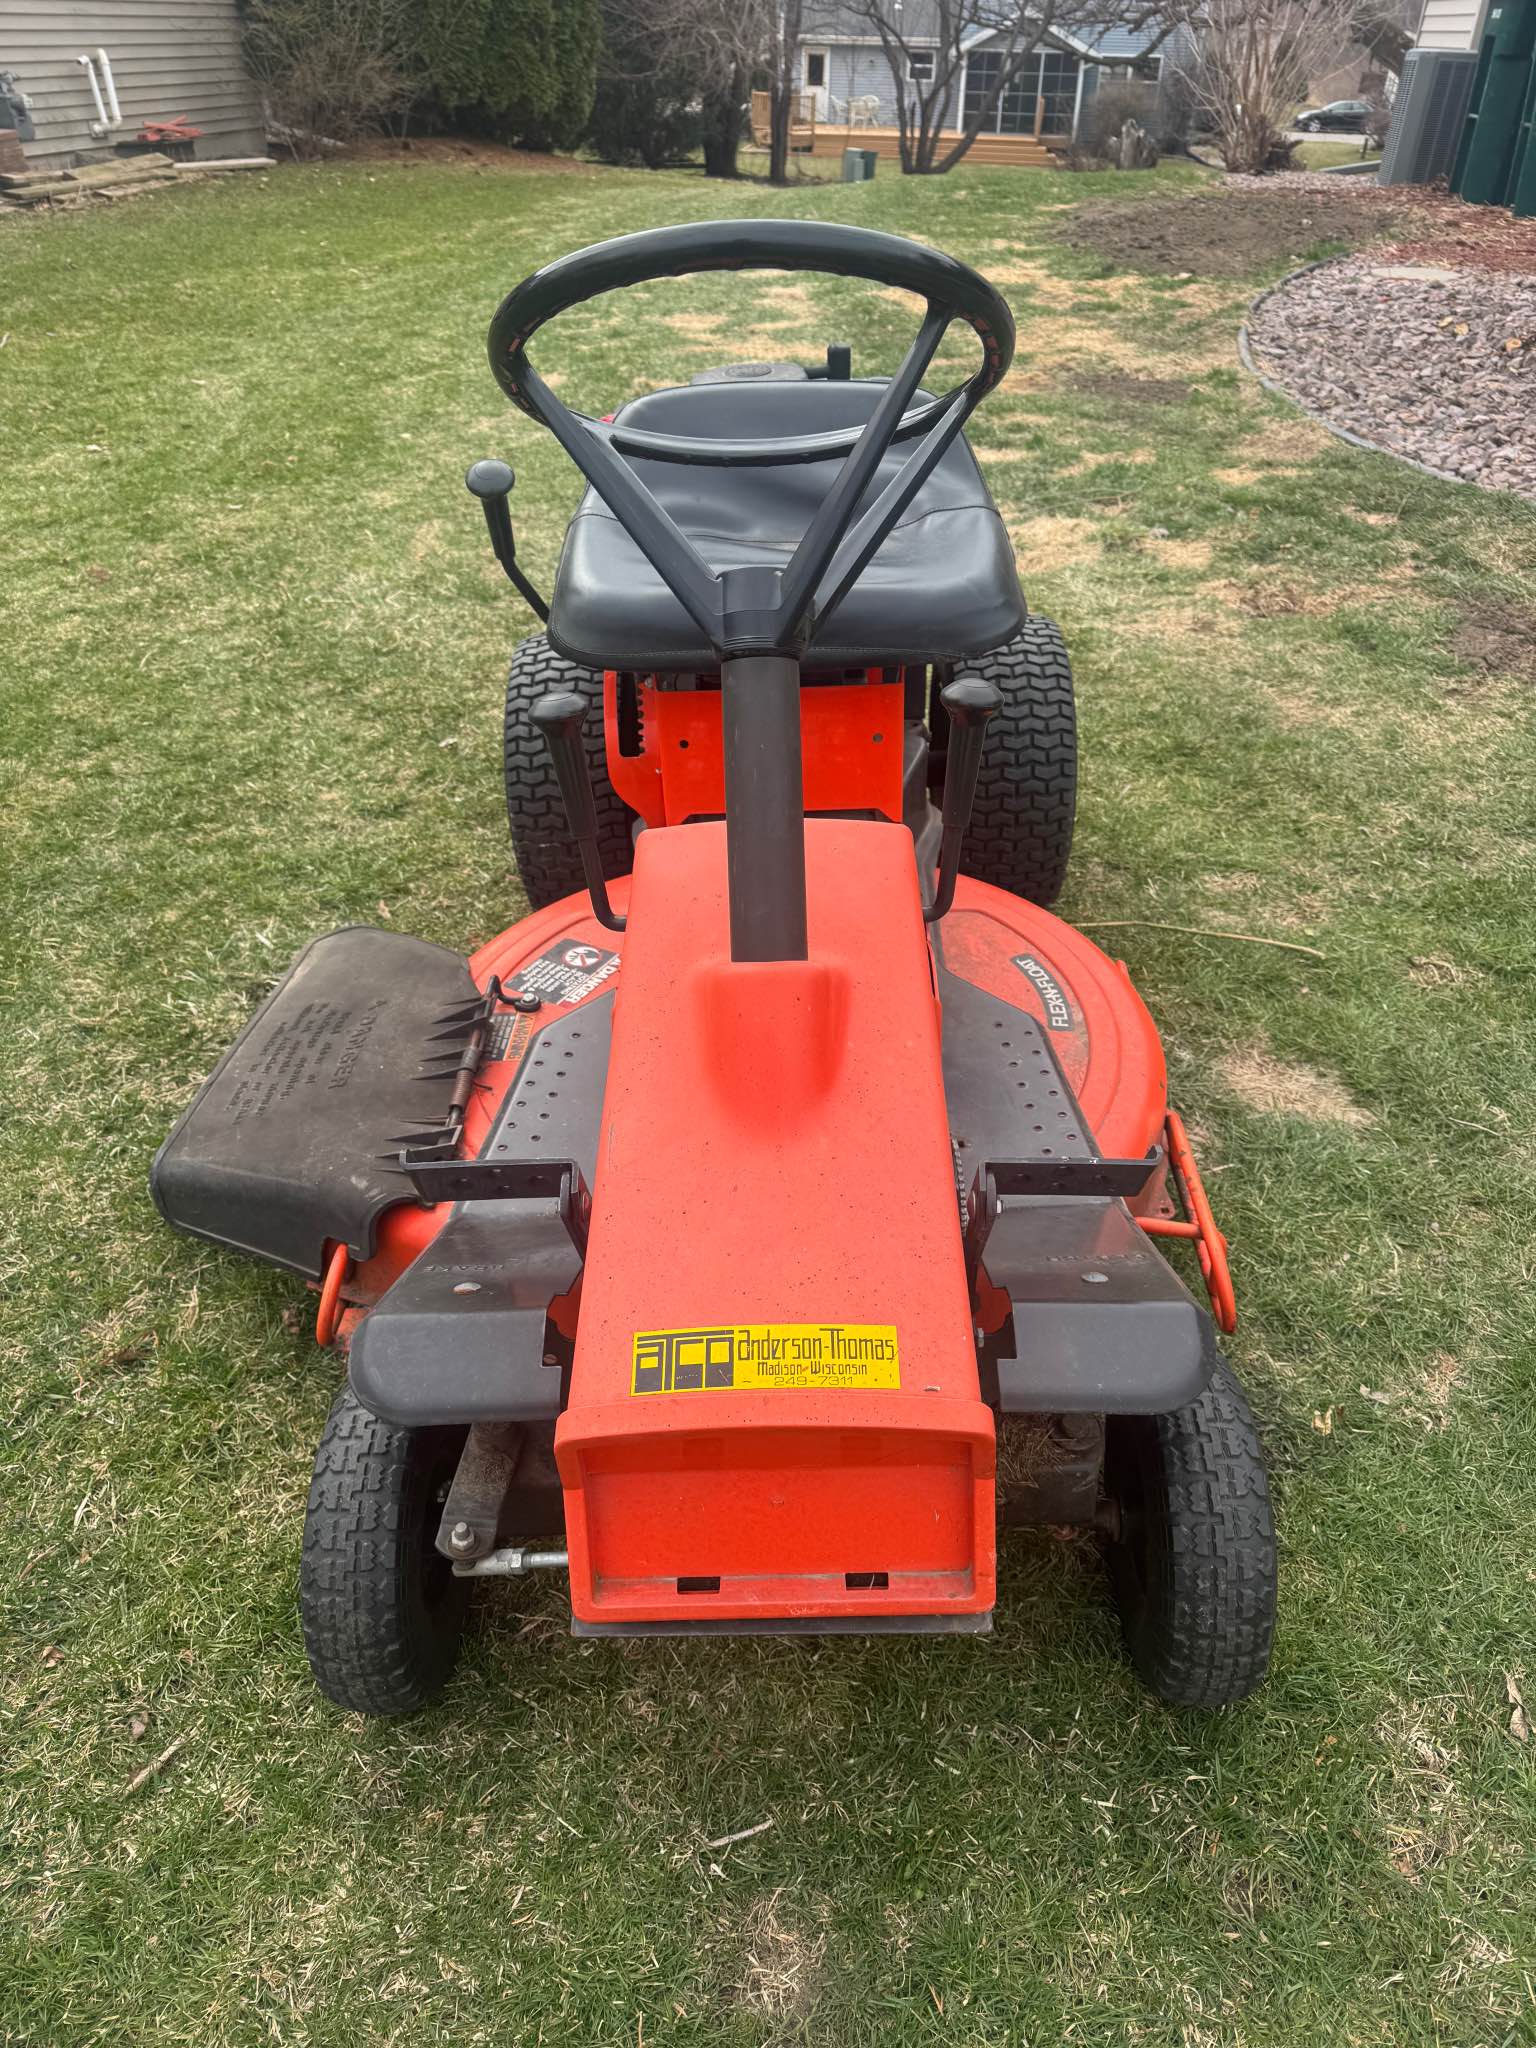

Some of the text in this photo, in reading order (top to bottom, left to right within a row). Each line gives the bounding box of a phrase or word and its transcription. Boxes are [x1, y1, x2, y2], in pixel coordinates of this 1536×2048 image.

[566, 965, 614, 1004] DANGER
[1016, 957, 1070, 1028] FLEX-N-FLOAT
[328, 1012, 377, 1090] DANGER
[774, 1375, 853, 1387] 249-7311
